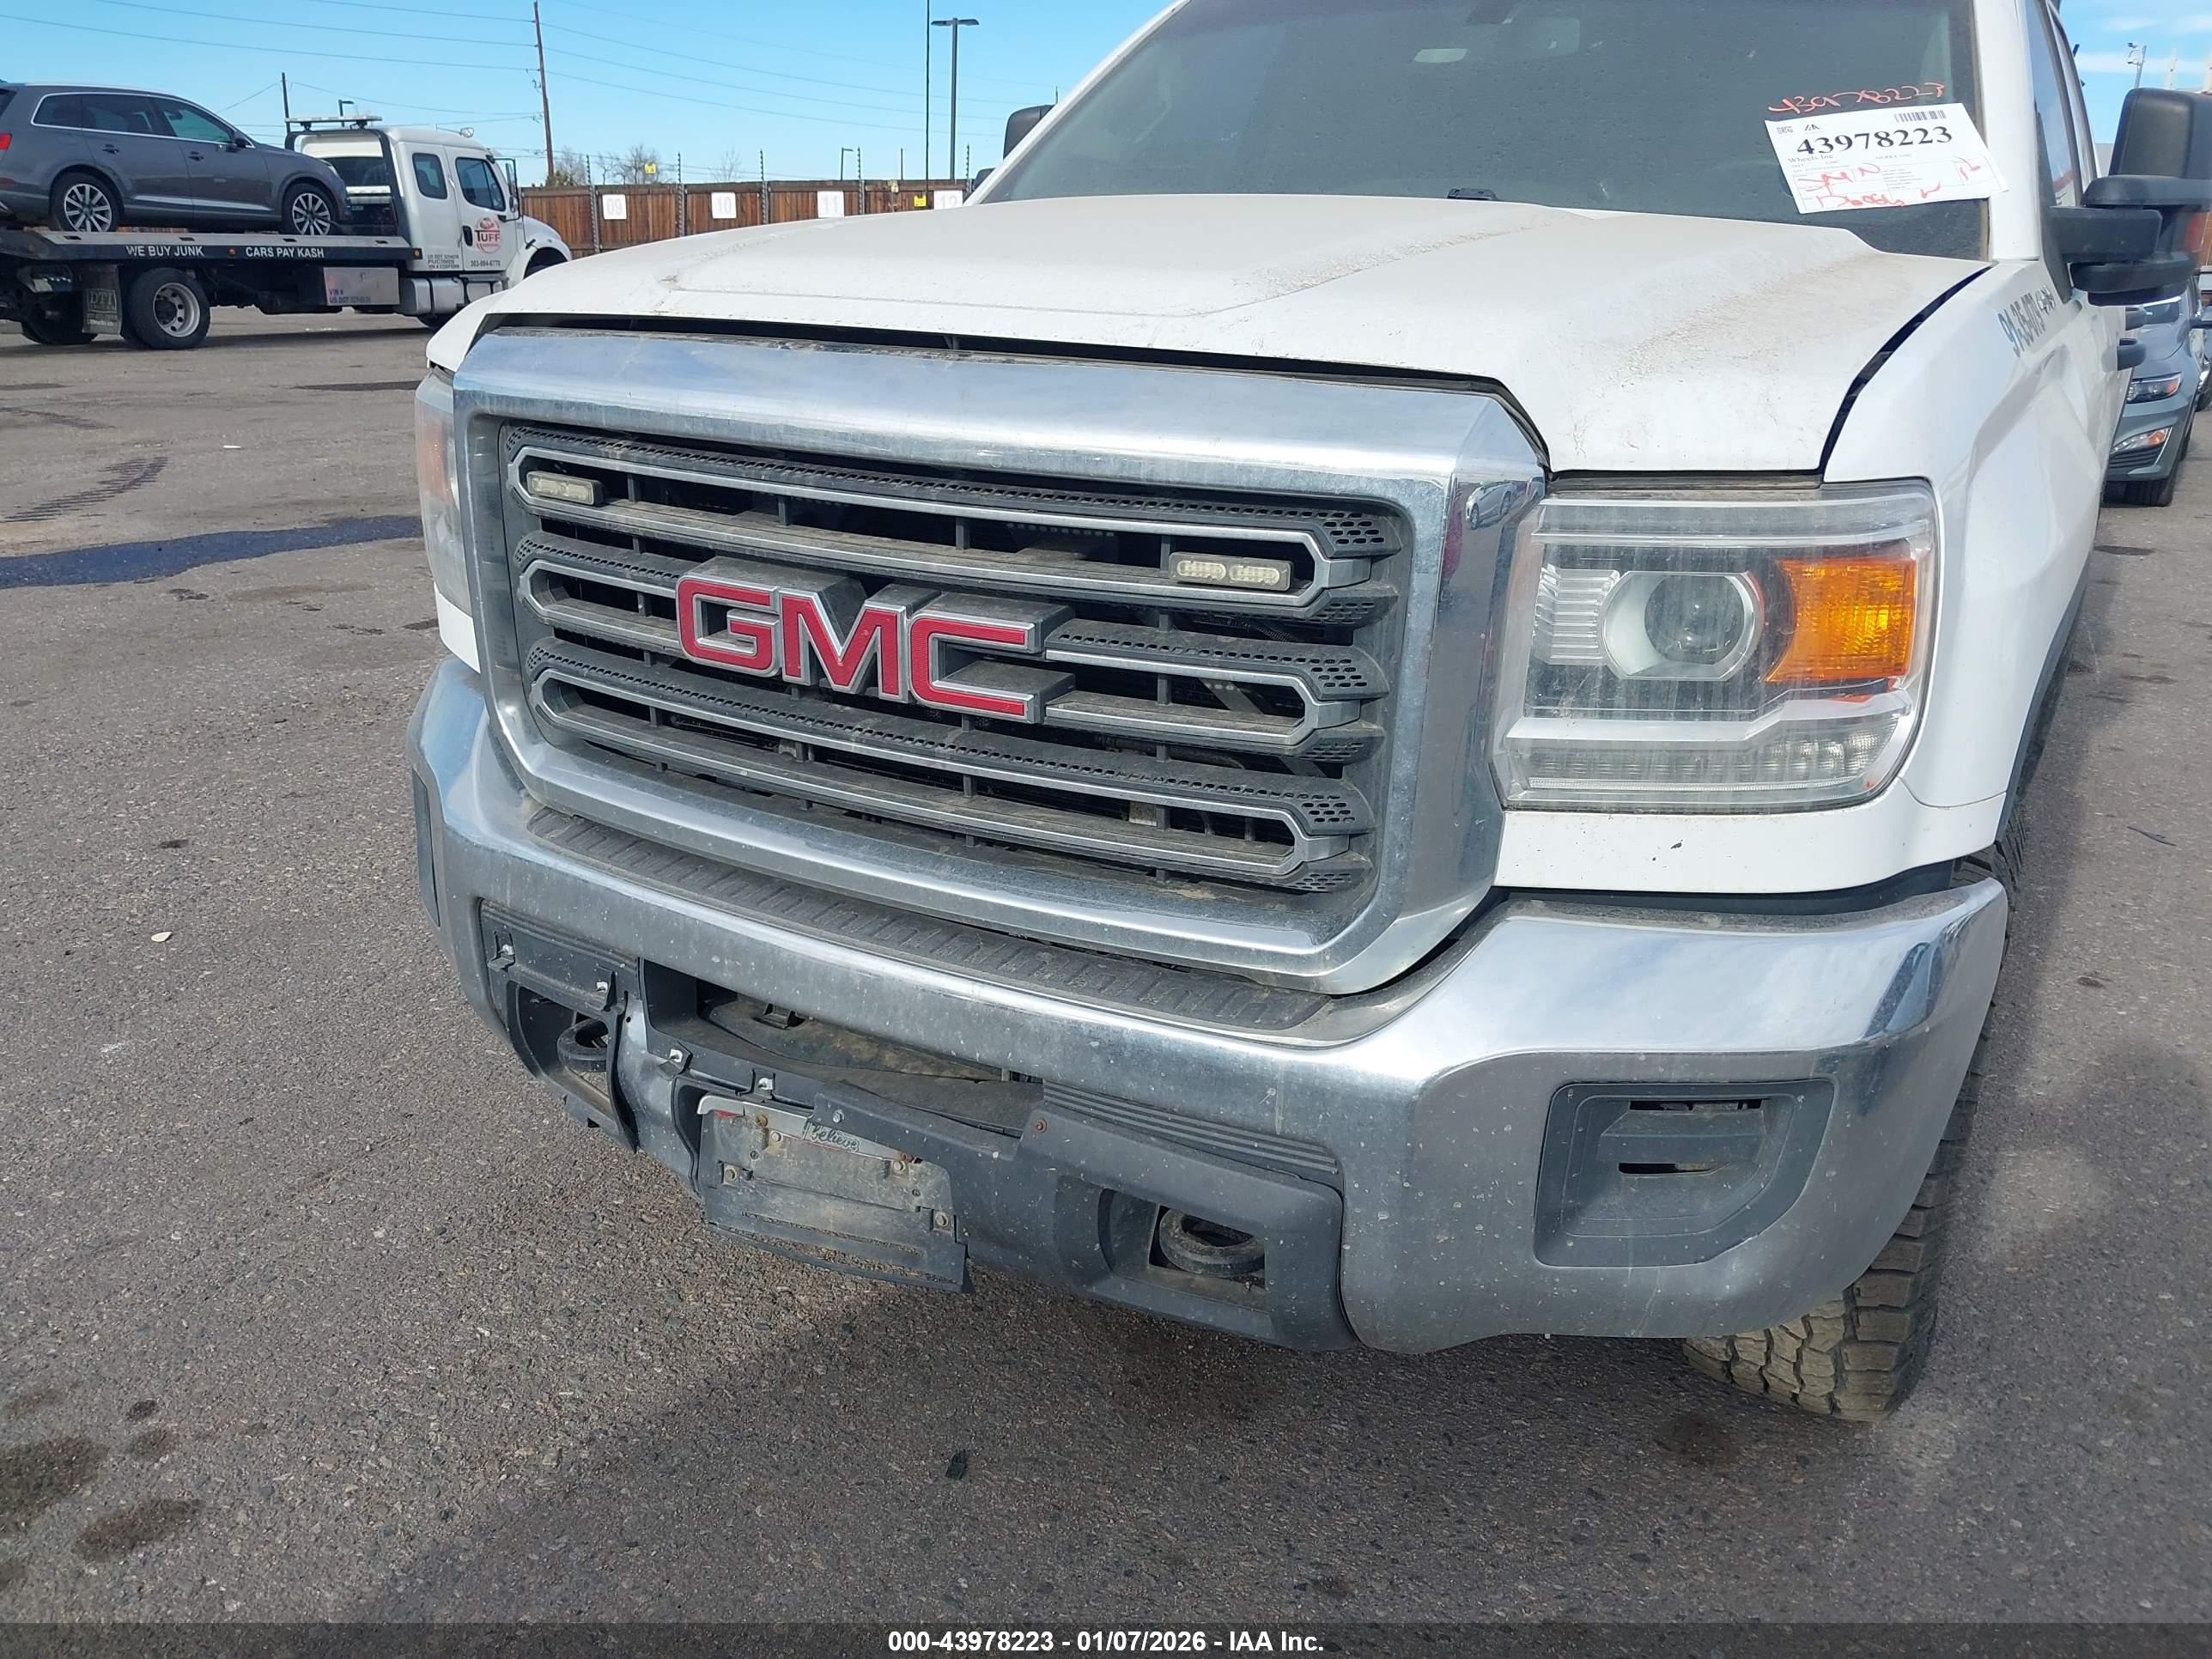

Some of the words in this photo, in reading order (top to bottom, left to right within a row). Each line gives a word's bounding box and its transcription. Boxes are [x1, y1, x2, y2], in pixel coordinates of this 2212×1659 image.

[1797, 125, 1953, 155] 43978223
[823, 196, 838, 214] 11
[474, 229, 501, 242] TUFF
[126, 246, 145, 257] WE
[149, 246, 172, 257] BUY
[174, 246, 204, 257] JUNK
[246, 246, 274, 257] CARS
[276, 247, 295, 258] PAY
[298, 247, 325, 258] KASH
[675, 572, 1034, 724] GMC
